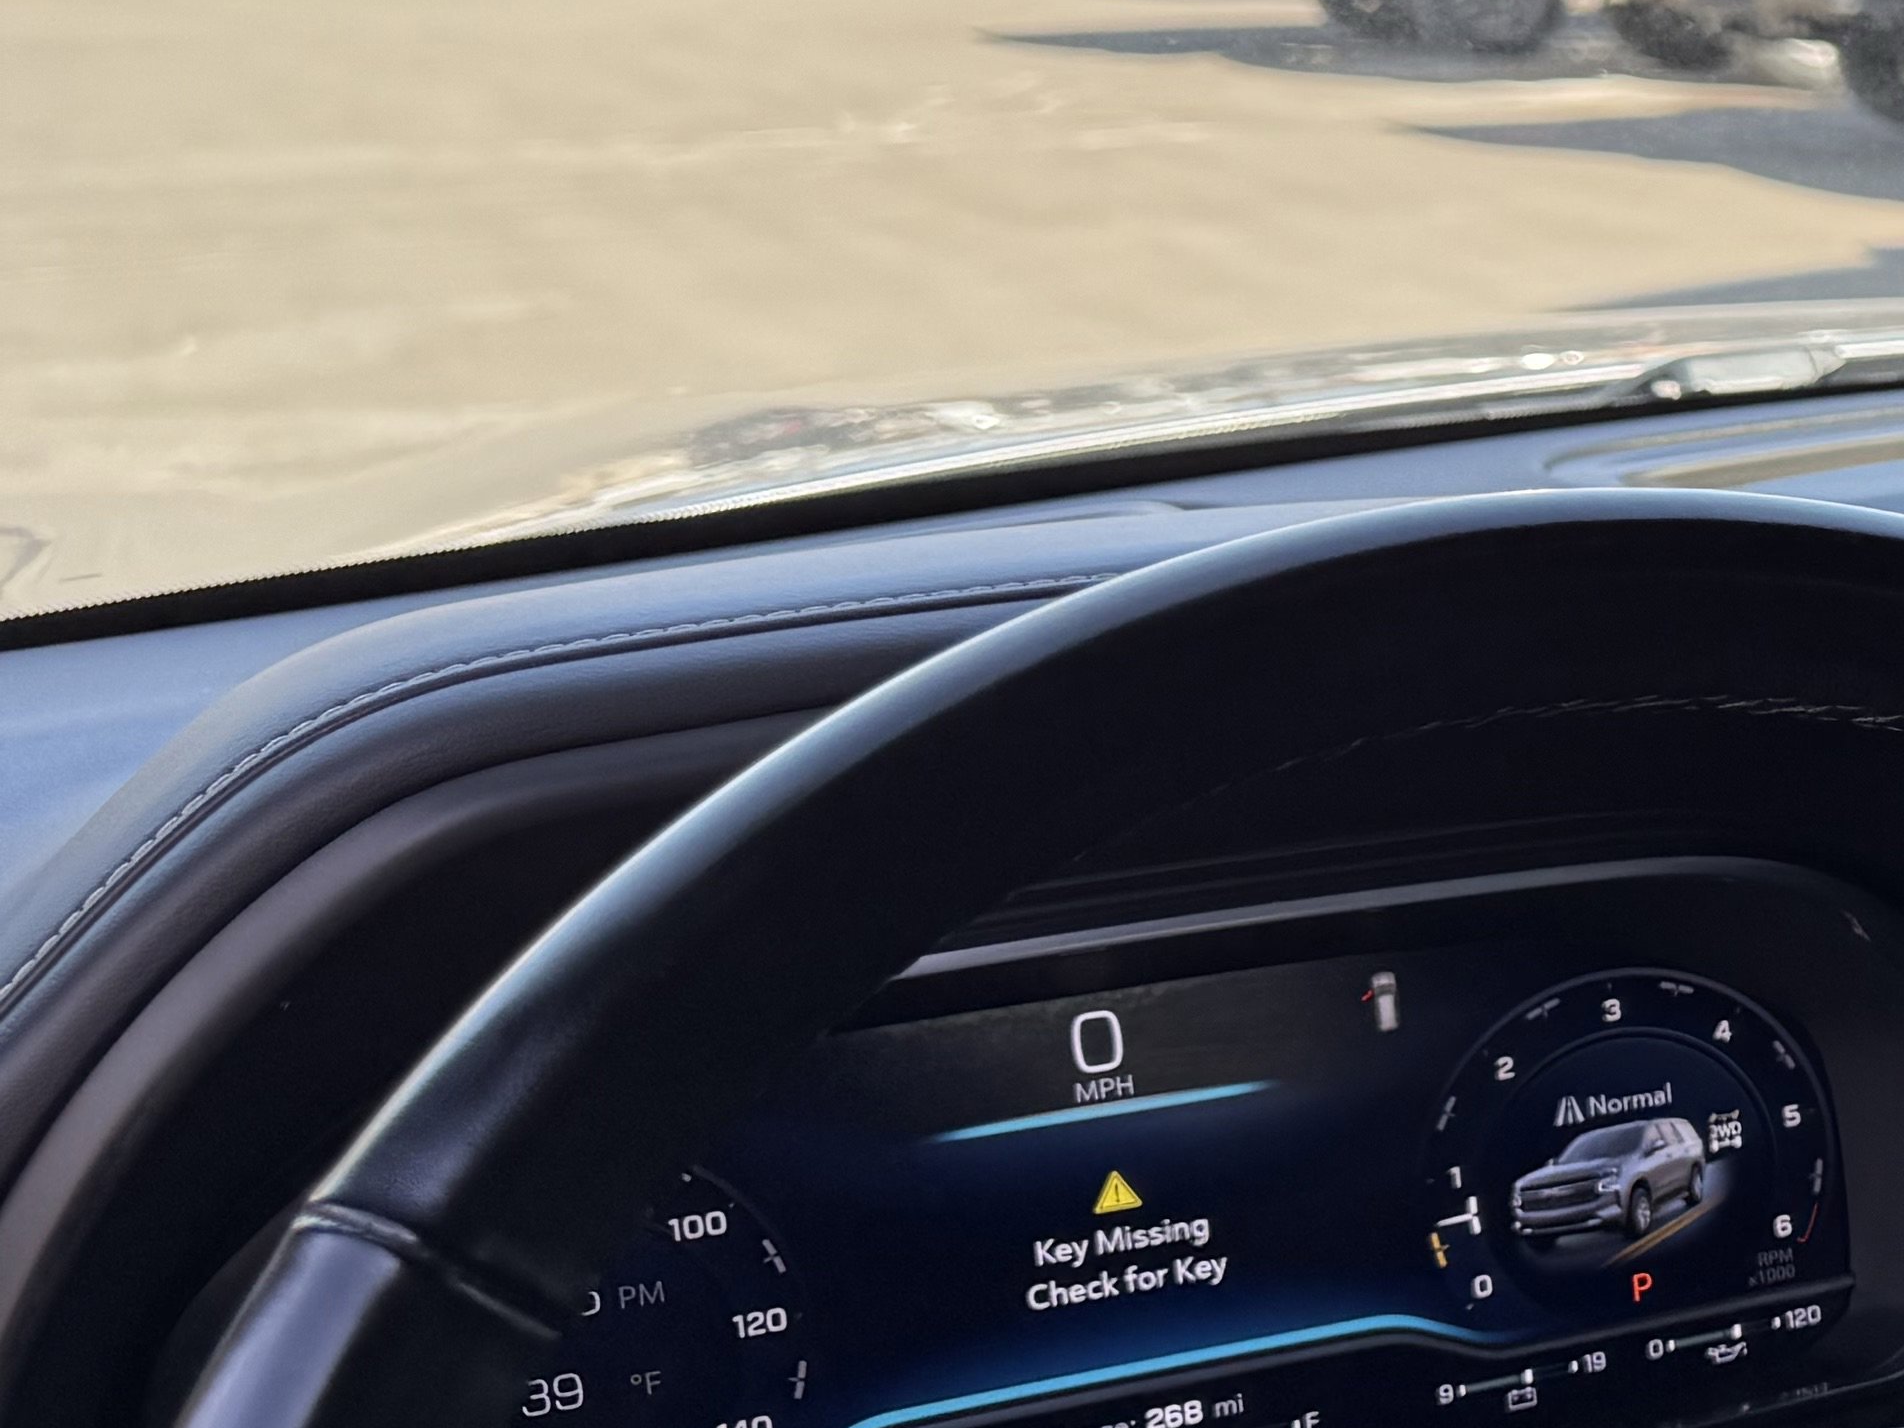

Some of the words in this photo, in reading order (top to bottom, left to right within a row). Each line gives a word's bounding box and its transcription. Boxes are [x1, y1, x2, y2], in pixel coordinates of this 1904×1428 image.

[1602, 998, 1622, 1022] 3
[1071, 1009, 1124, 1074] 0
[1714, 1019, 1732, 1042] 4
[1496, 1056, 1516, 1081] 2
[1074, 1076, 1136, 1103] MPH
[1588, 1083, 1673, 1116] Normal
[1783, 1104, 1802, 1128] 5
[1449, 1166, 1462, 1189] 1
[667, 1210, 727, 1242] 100
[1774, 1214, 1793, 1238] 6
[1034, 1238, 1089, 1268] Key
[1095, 1217, 1211, 1249] Missing
[1757, 1246, 1795, 1267] RPM
[618, 1280, 665, 1310] PM
[1027, 1270, 1120, 1310] Check
[1123, 1264, 1169, 1293] for
[1174, 1256, 1228, 1286] Key
[1473, 1274, 1493, 1298] 0
[1632, 1272, 1653, 1302] P
[732, 1307, 788, 1339] 120
[1785, 1304, 1822, 1329] 120
[1648, 1338, 1664, 1359] 0
[1583, 1351, 1607, 1373] 19
[522, 1372, 584, 1417] 39
[1214, 1392, 1244, 1418] mi
[1438, 1383, 1454, 1405] 9
